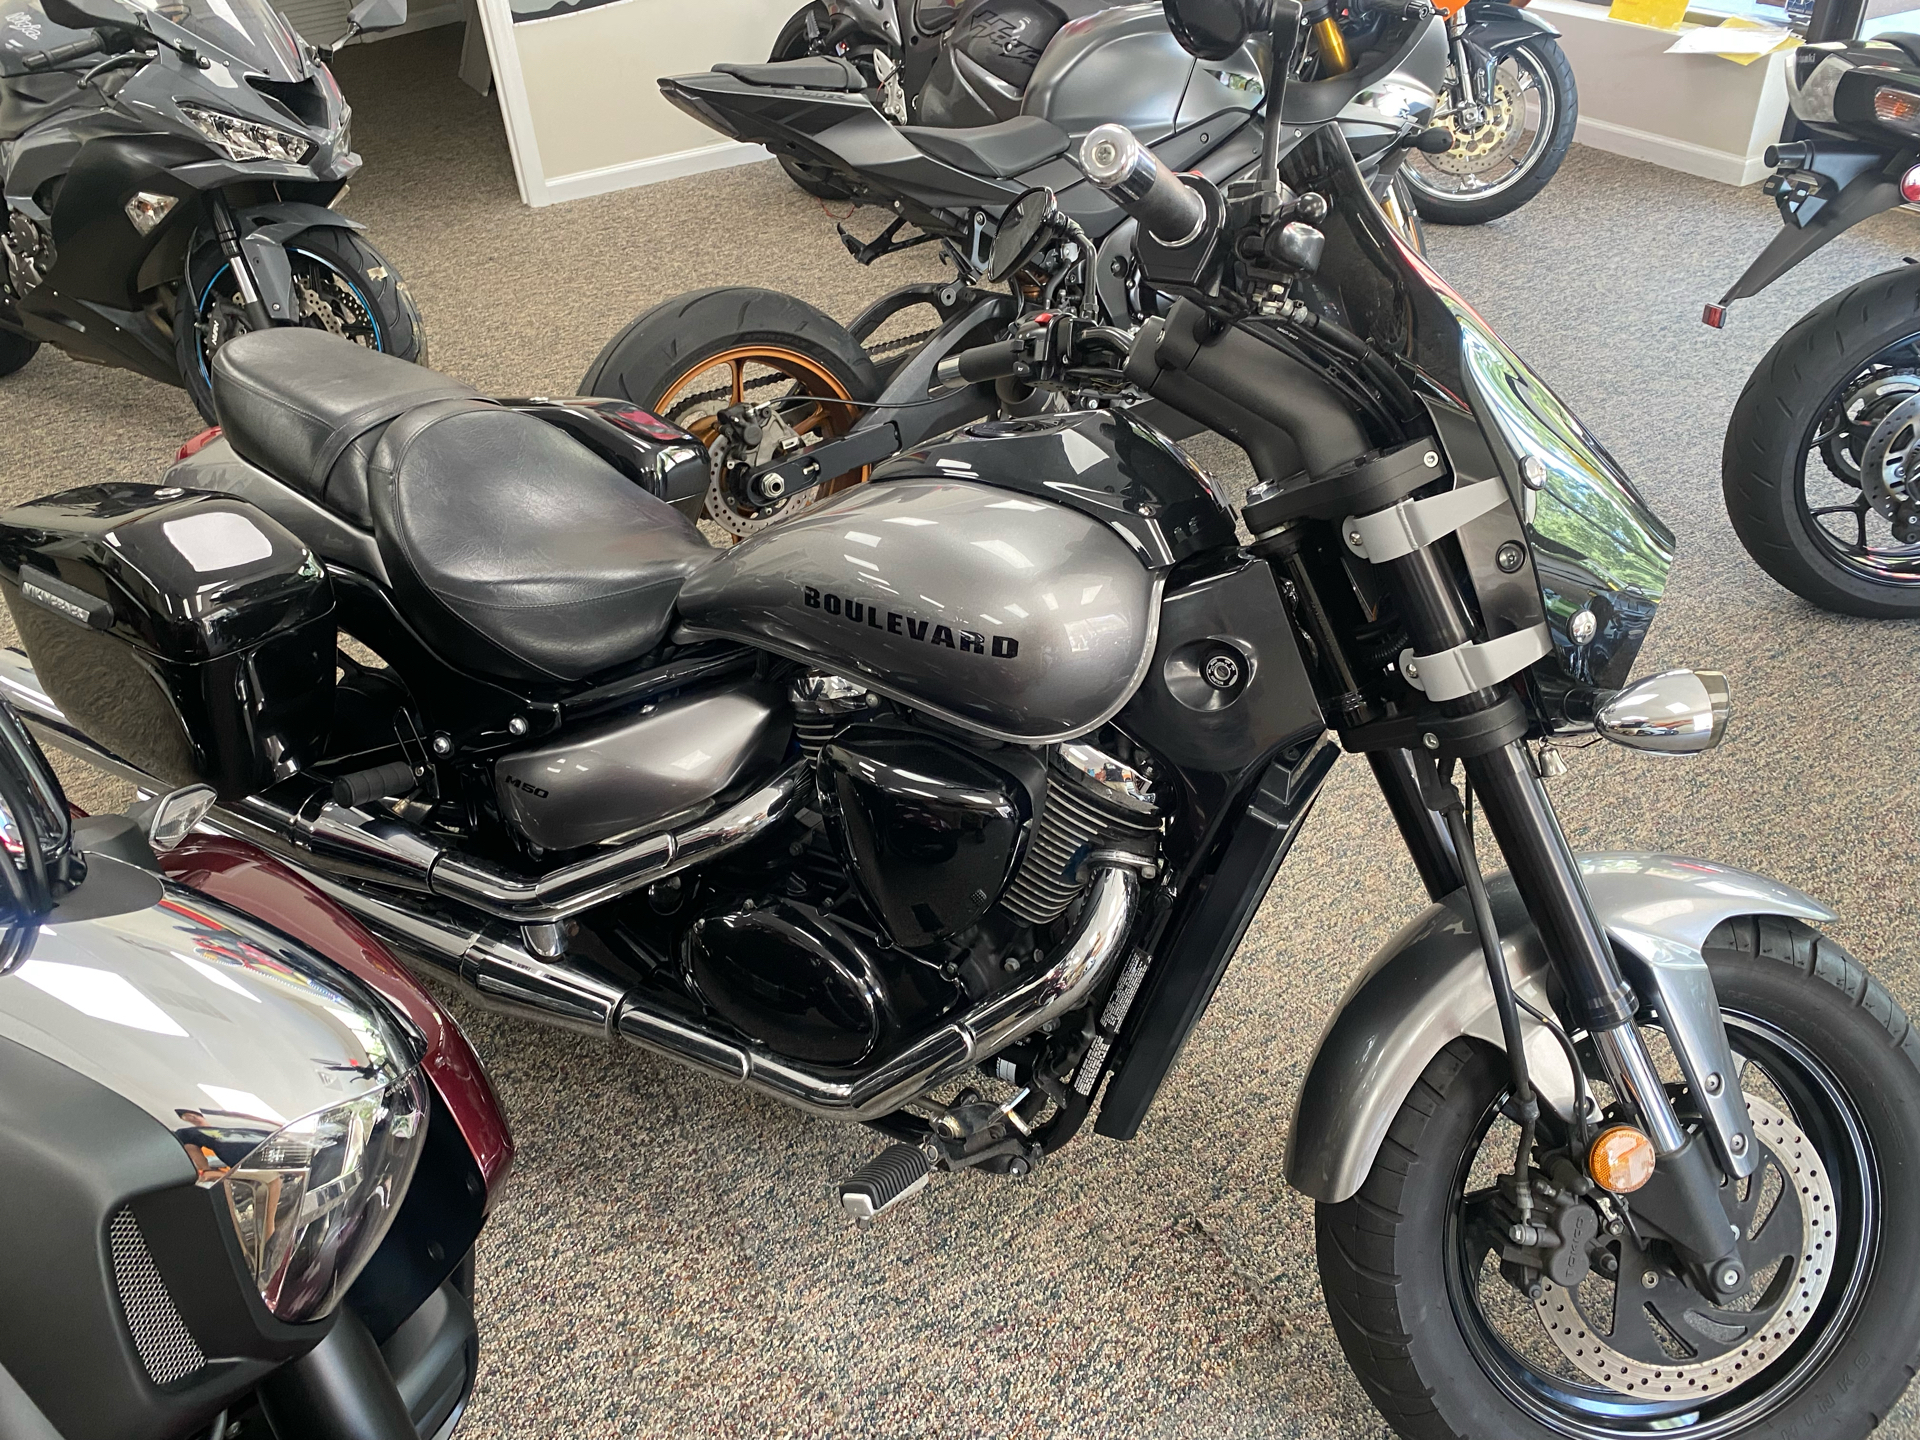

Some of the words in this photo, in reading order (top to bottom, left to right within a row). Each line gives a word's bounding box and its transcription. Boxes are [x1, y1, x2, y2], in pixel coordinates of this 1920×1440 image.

[5, 12, 41, 40] Ninja
[804, 585, 1019, 659] BOULEVARD
[505, 775, 549, 799] M50
[1566, 1216, 1584, 1278] TOKICO
[1781, 1350, 1871, 1440] HINKO
